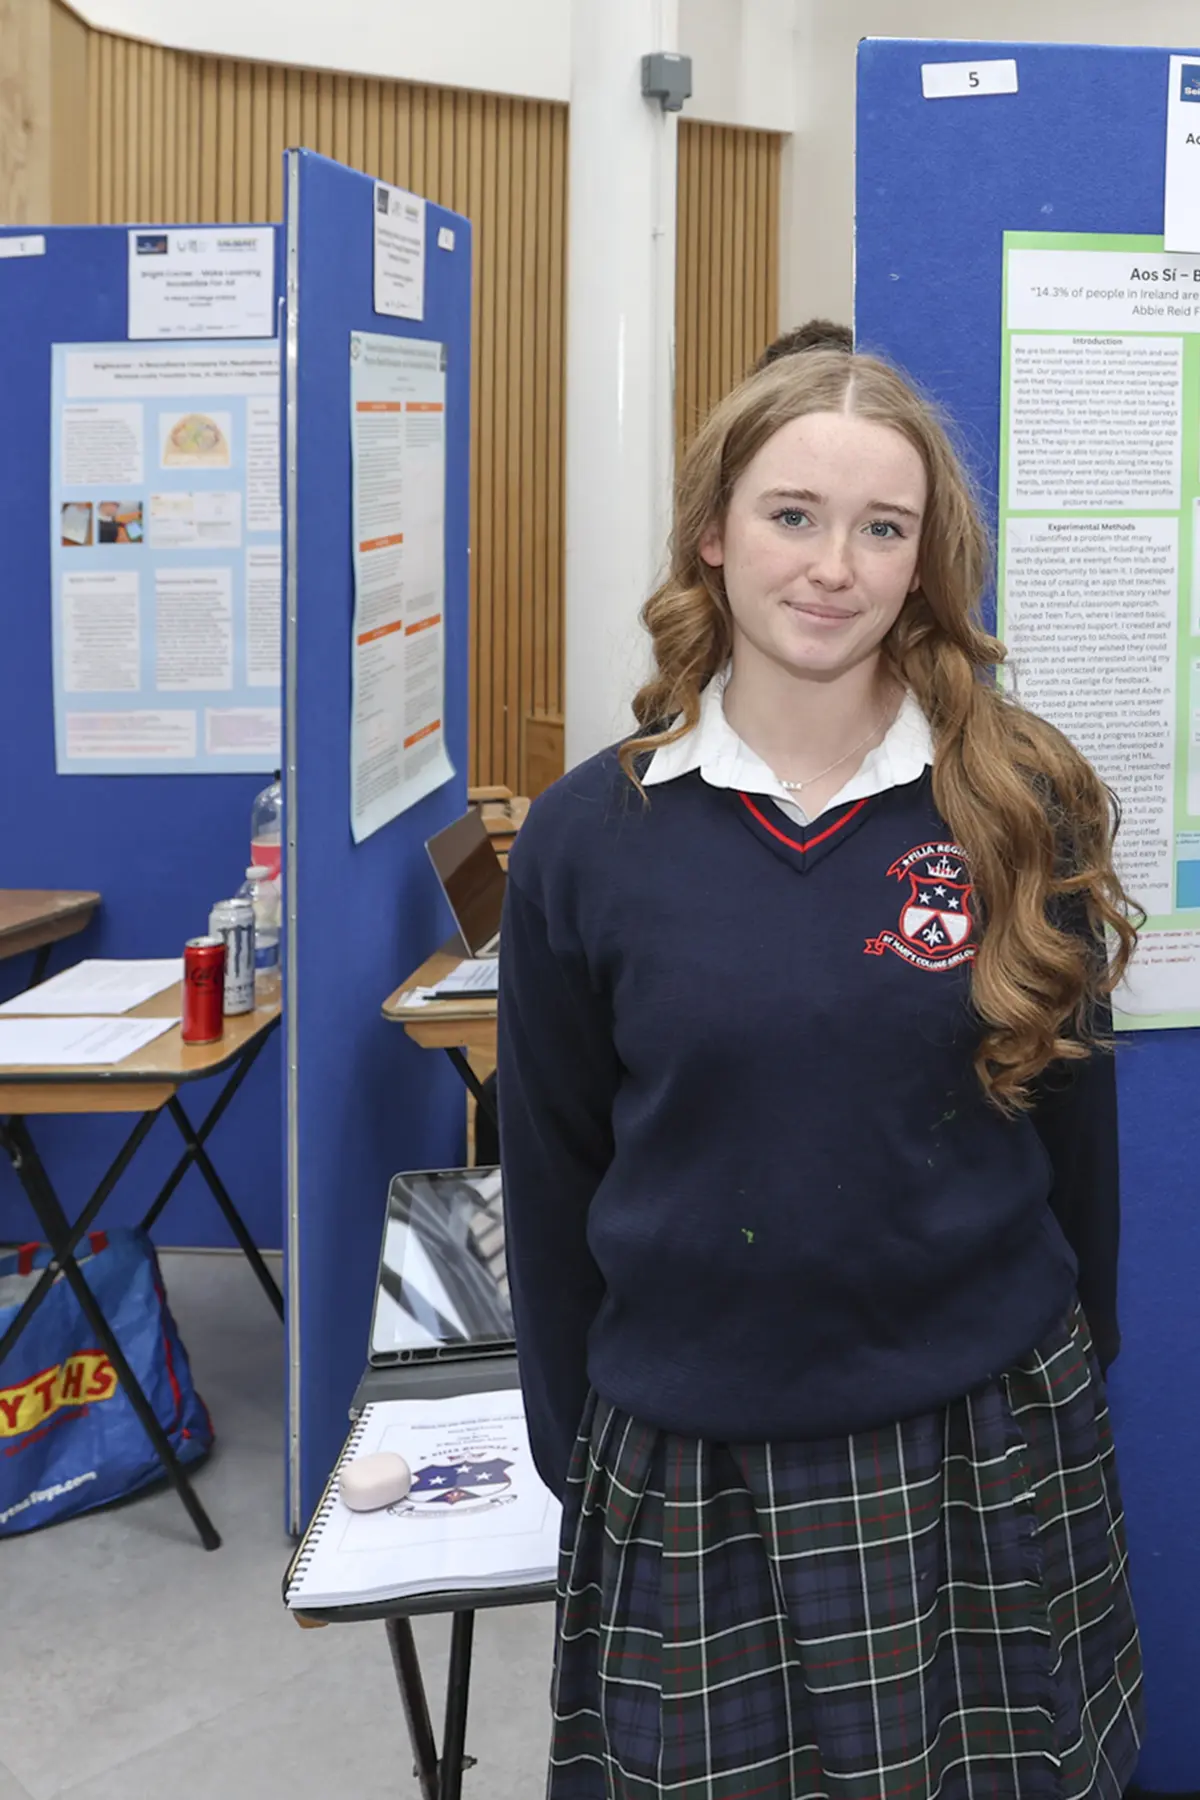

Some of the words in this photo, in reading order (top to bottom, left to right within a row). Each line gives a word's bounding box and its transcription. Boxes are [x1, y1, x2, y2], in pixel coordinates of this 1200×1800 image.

[969, 72, 980, 88] 5
[1130, 268, 1158, 281] Aos
[1071, 287, 1083, 297] of
[1086, 288, 1124, 300] people
[1127, 289, 1137, 298] in
[1140, 289, 1178, 299] Ireland
[1181, 292, 1199, 300] are
[1132, 305, 1164, 315] Abbie
[1167, 305, 1190, 316] Reid
[1072, 336, 1122, 345] Introduction
[1048, 523, 1099, 532] Experimental
